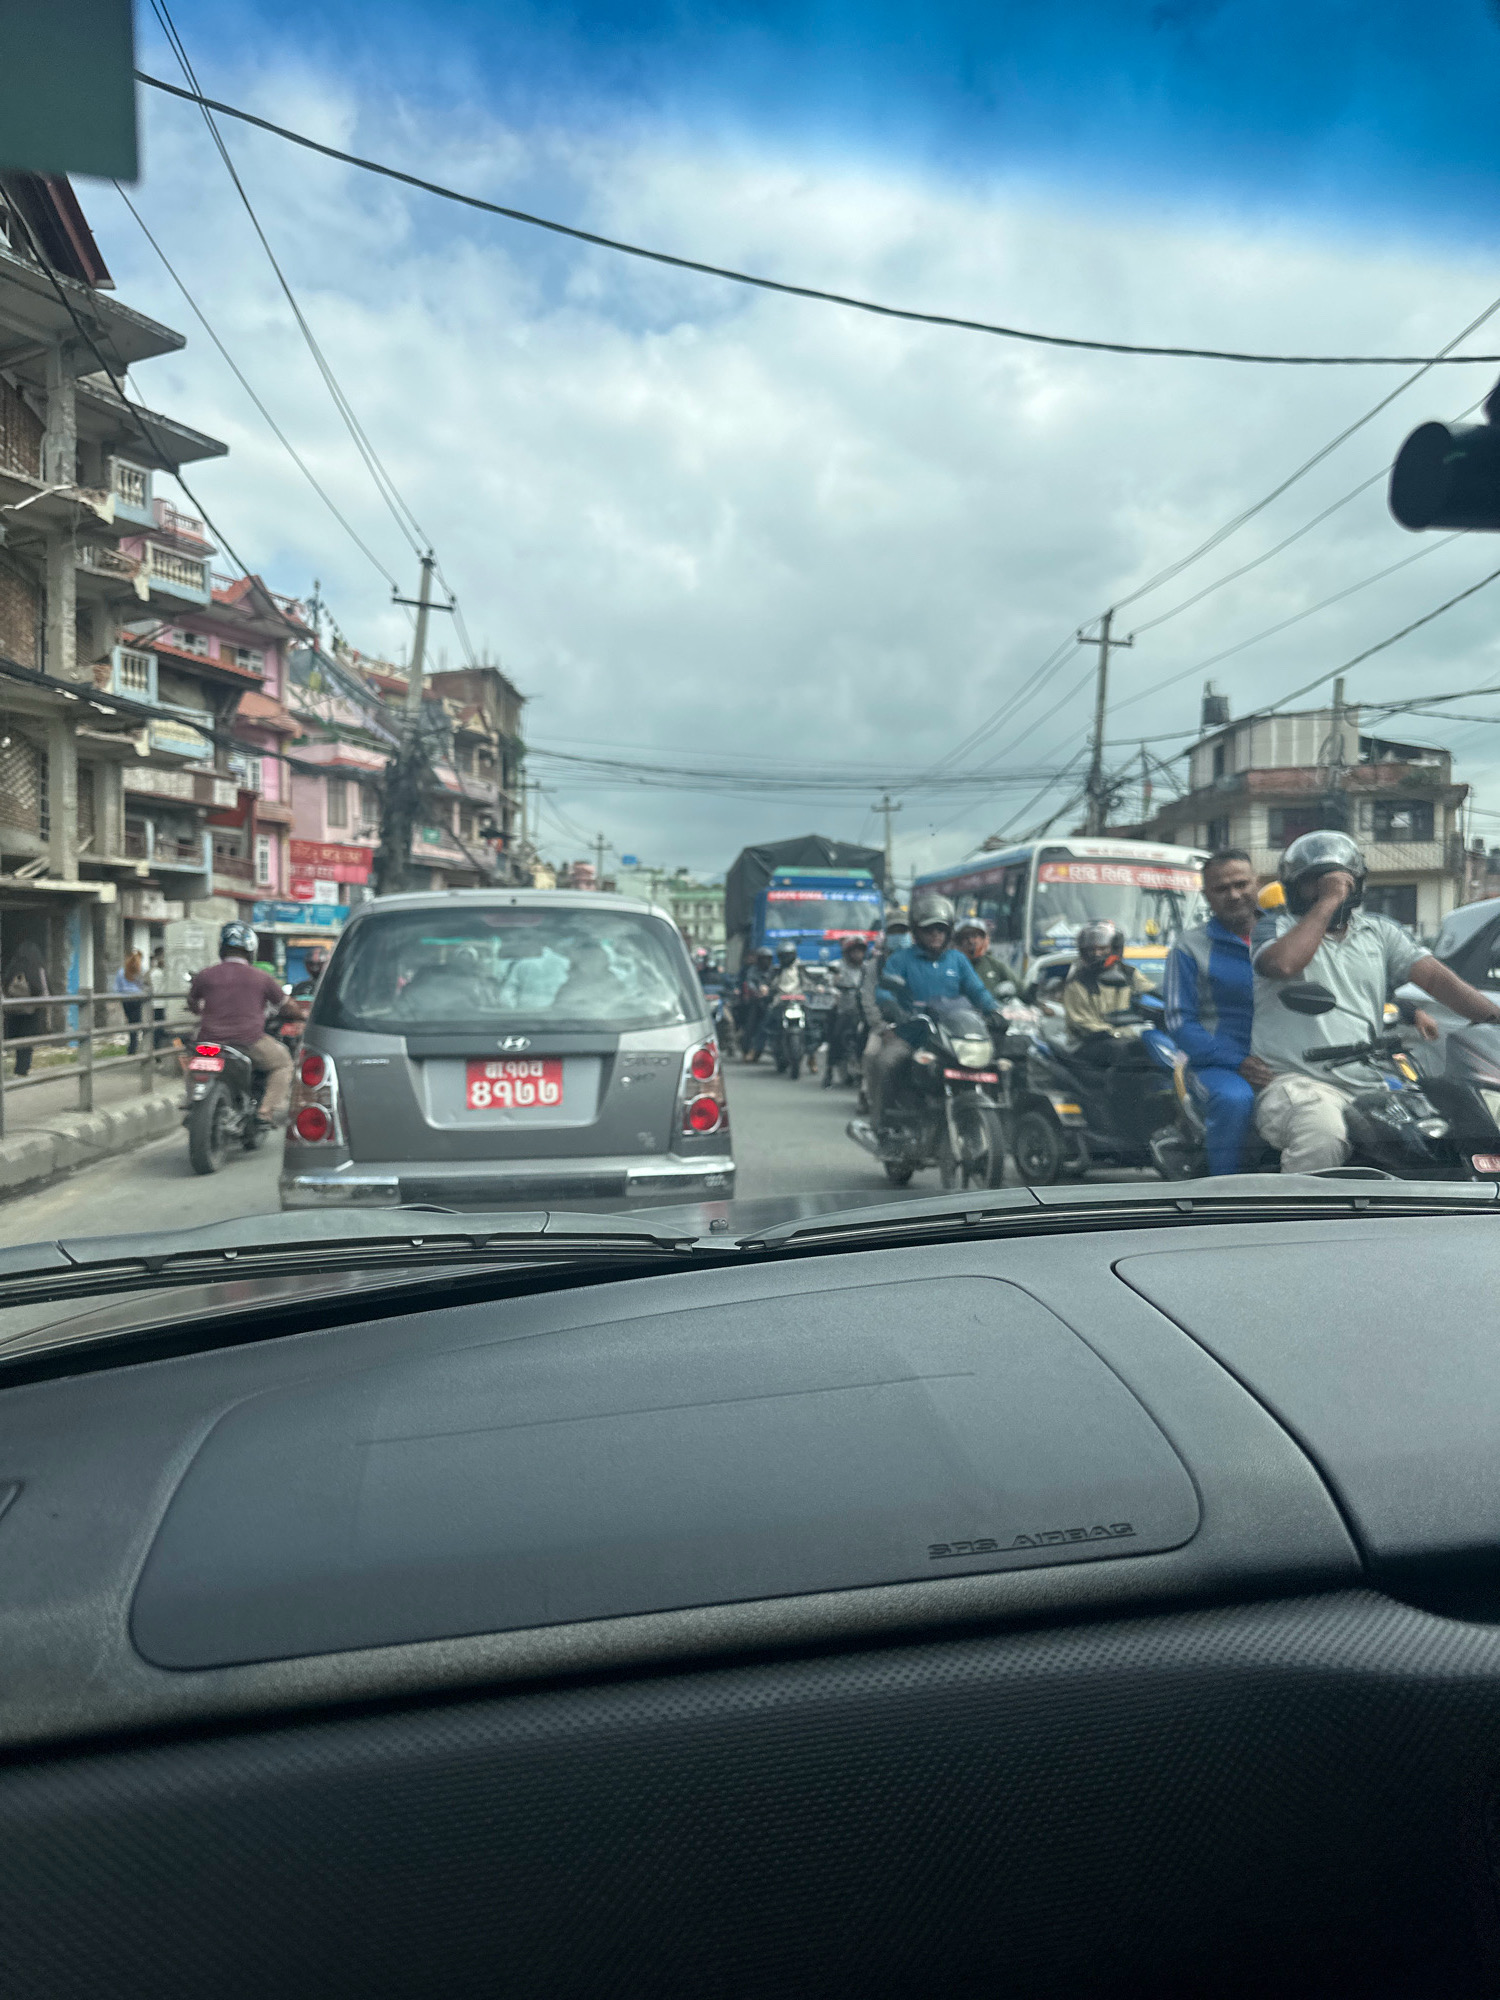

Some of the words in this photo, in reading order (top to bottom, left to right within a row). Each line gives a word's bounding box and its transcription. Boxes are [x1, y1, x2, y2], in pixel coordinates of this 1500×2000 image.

[471, 1078, 560, 1107] ४१७७
[927, 1538, 999, 1557] SRS
[1012, 1522, 1134, 1547] AIRBAG
